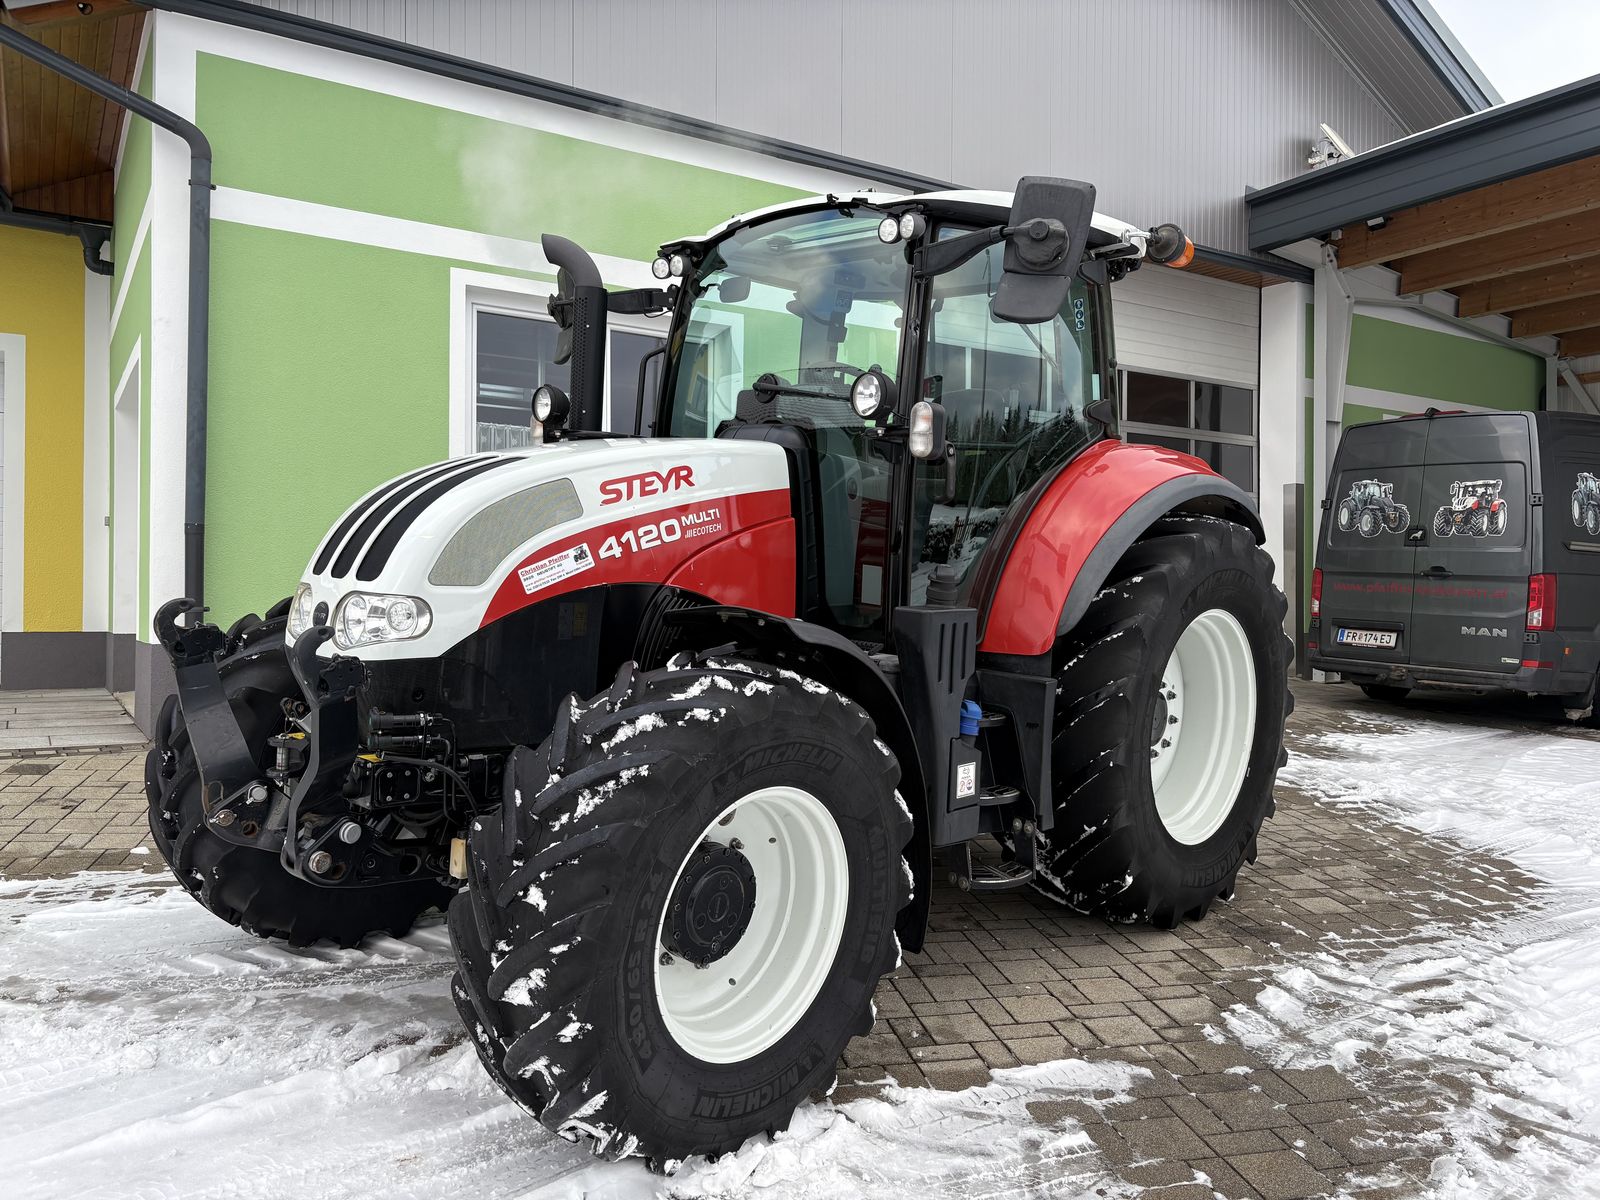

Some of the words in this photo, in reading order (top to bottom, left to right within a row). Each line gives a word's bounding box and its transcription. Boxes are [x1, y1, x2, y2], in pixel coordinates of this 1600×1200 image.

[599, 465, 695, 506] STEYR
[598, 519, 682, 559] 4120
[681, 508, 720, 527] MULTI
[520, 562, 548, 578] Christian
[547, 553, 571, 566] Pfeiffer
[1346, 631, 1358, 642] FR
[1461, 626, 1508, 638] MAN
[742, 742, 844, 777] MICHELIN
[693, 1065, 799, 1118] MICHELIN
